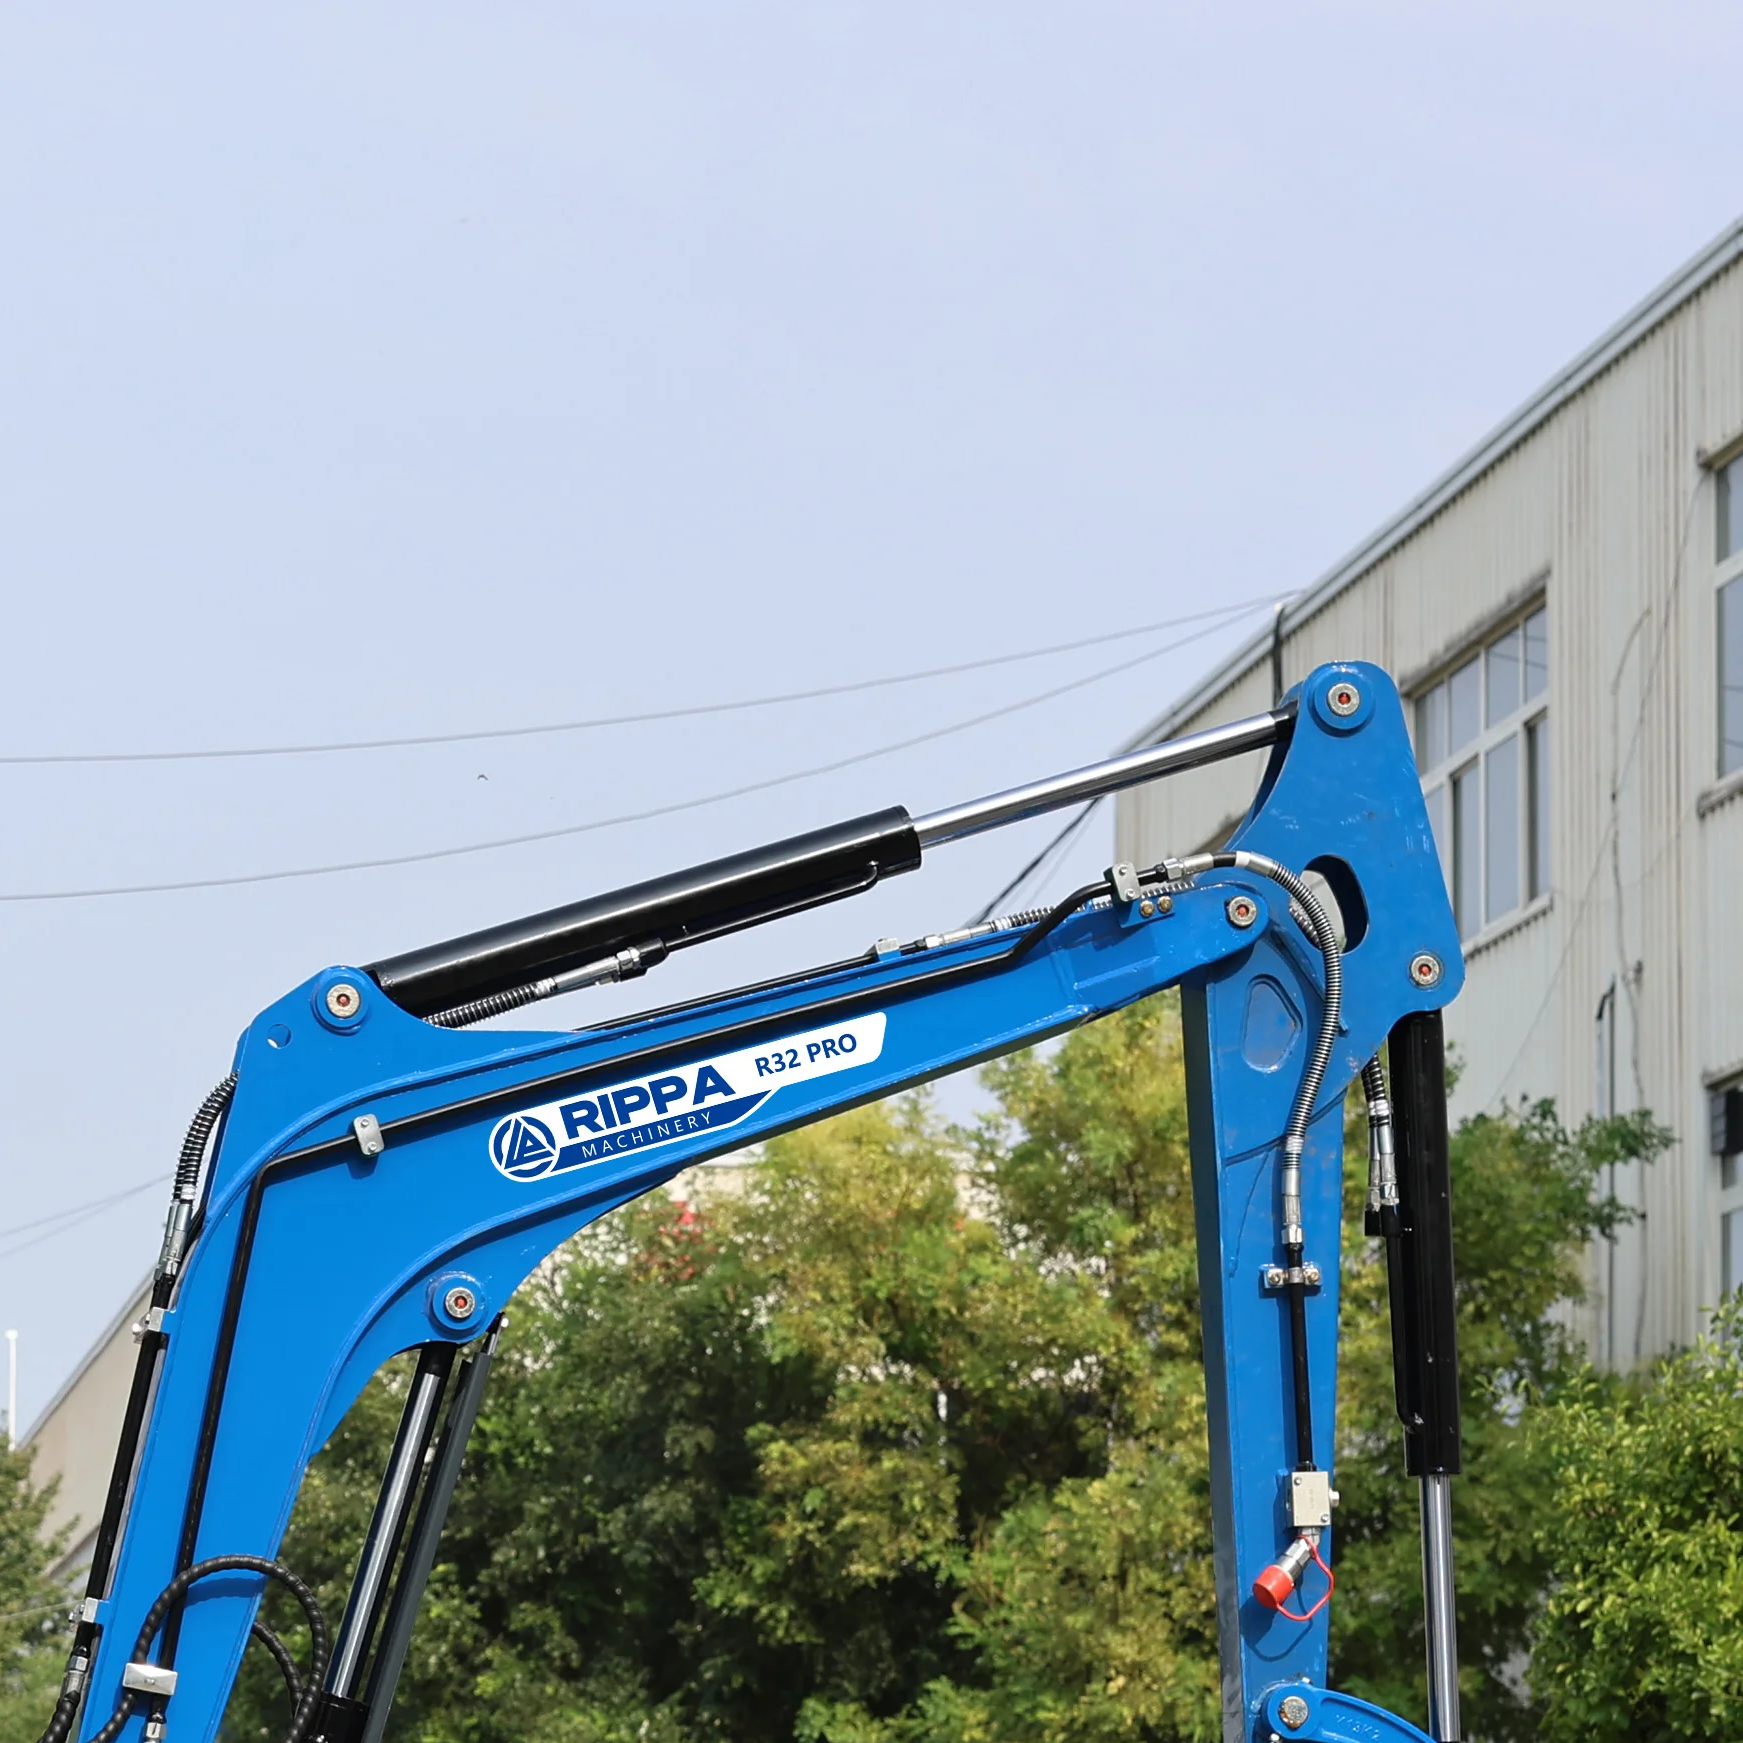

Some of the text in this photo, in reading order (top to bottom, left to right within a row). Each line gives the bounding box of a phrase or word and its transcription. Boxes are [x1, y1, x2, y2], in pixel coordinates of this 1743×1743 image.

[559, 1033, 857, 1140] RIPPA R32 PRO
[581, 1111, 711, 1158] MACHINERY
